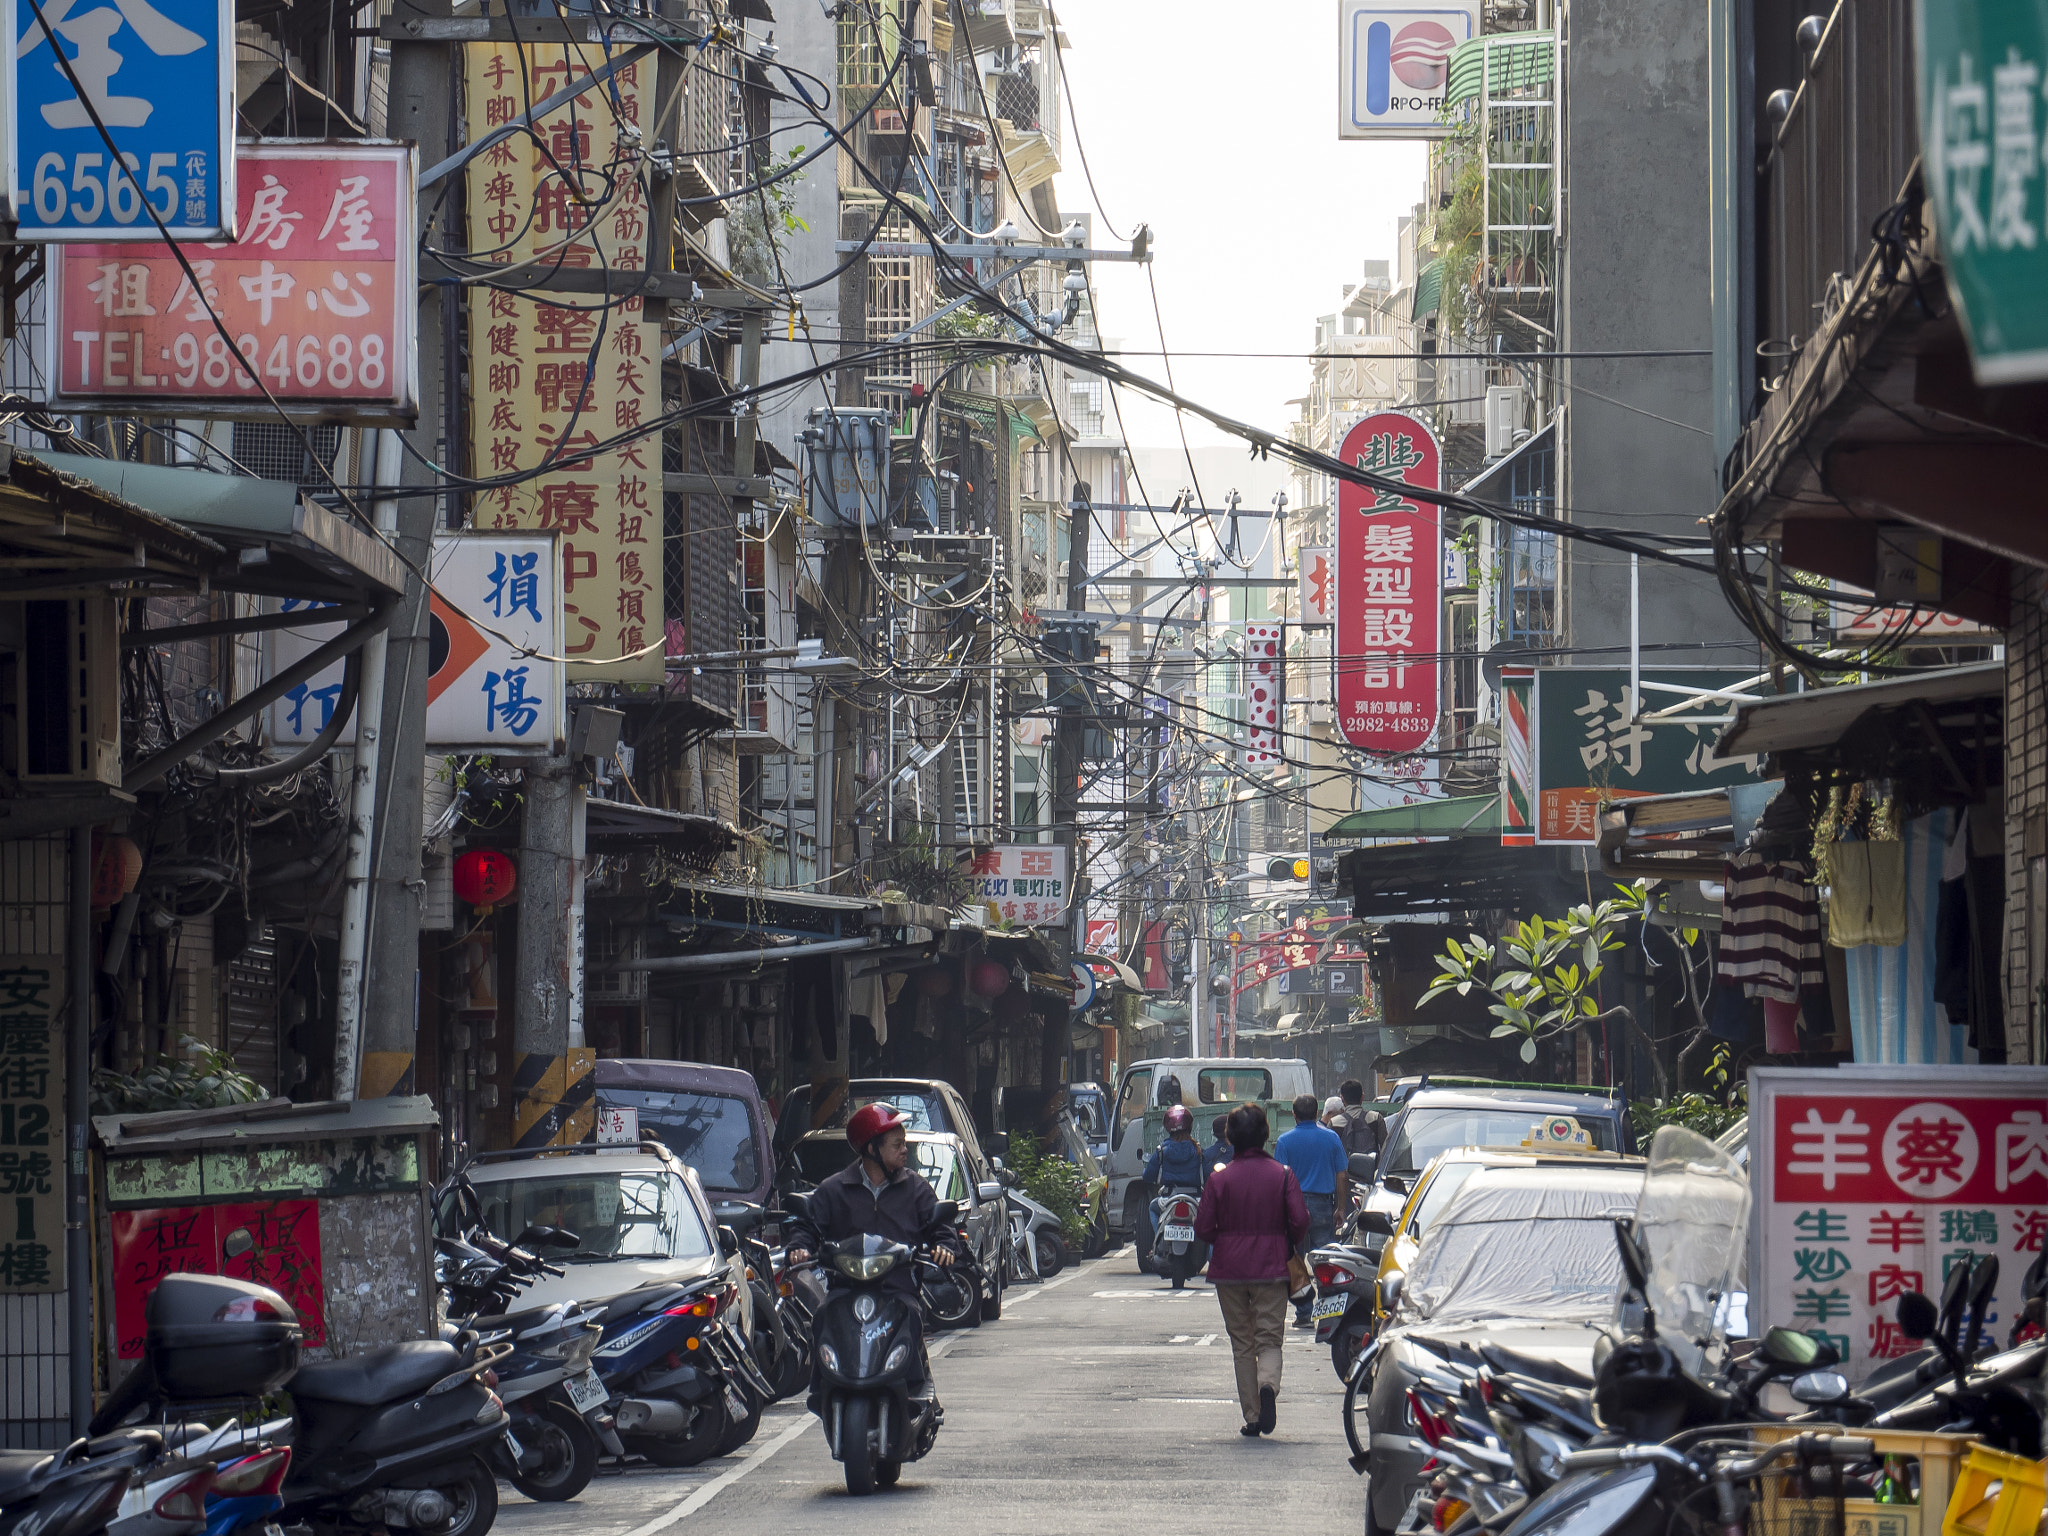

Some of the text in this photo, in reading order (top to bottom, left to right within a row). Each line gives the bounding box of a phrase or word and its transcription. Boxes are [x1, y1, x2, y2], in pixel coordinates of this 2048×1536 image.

[1948, 48, 2048, 252] 安慶
[88, 261, 372, 326] 租屋中心
[1363, 525, 1414, 689] 髮型設計
[482, 551, 543, 737] 損傷
[1346, 717, 1430, 733] 2982-4833
[969, 851, 1053, 876] 東亞
[141, 1212, 201, 1251] 租
[243, 1206, 311, 1250] 租
